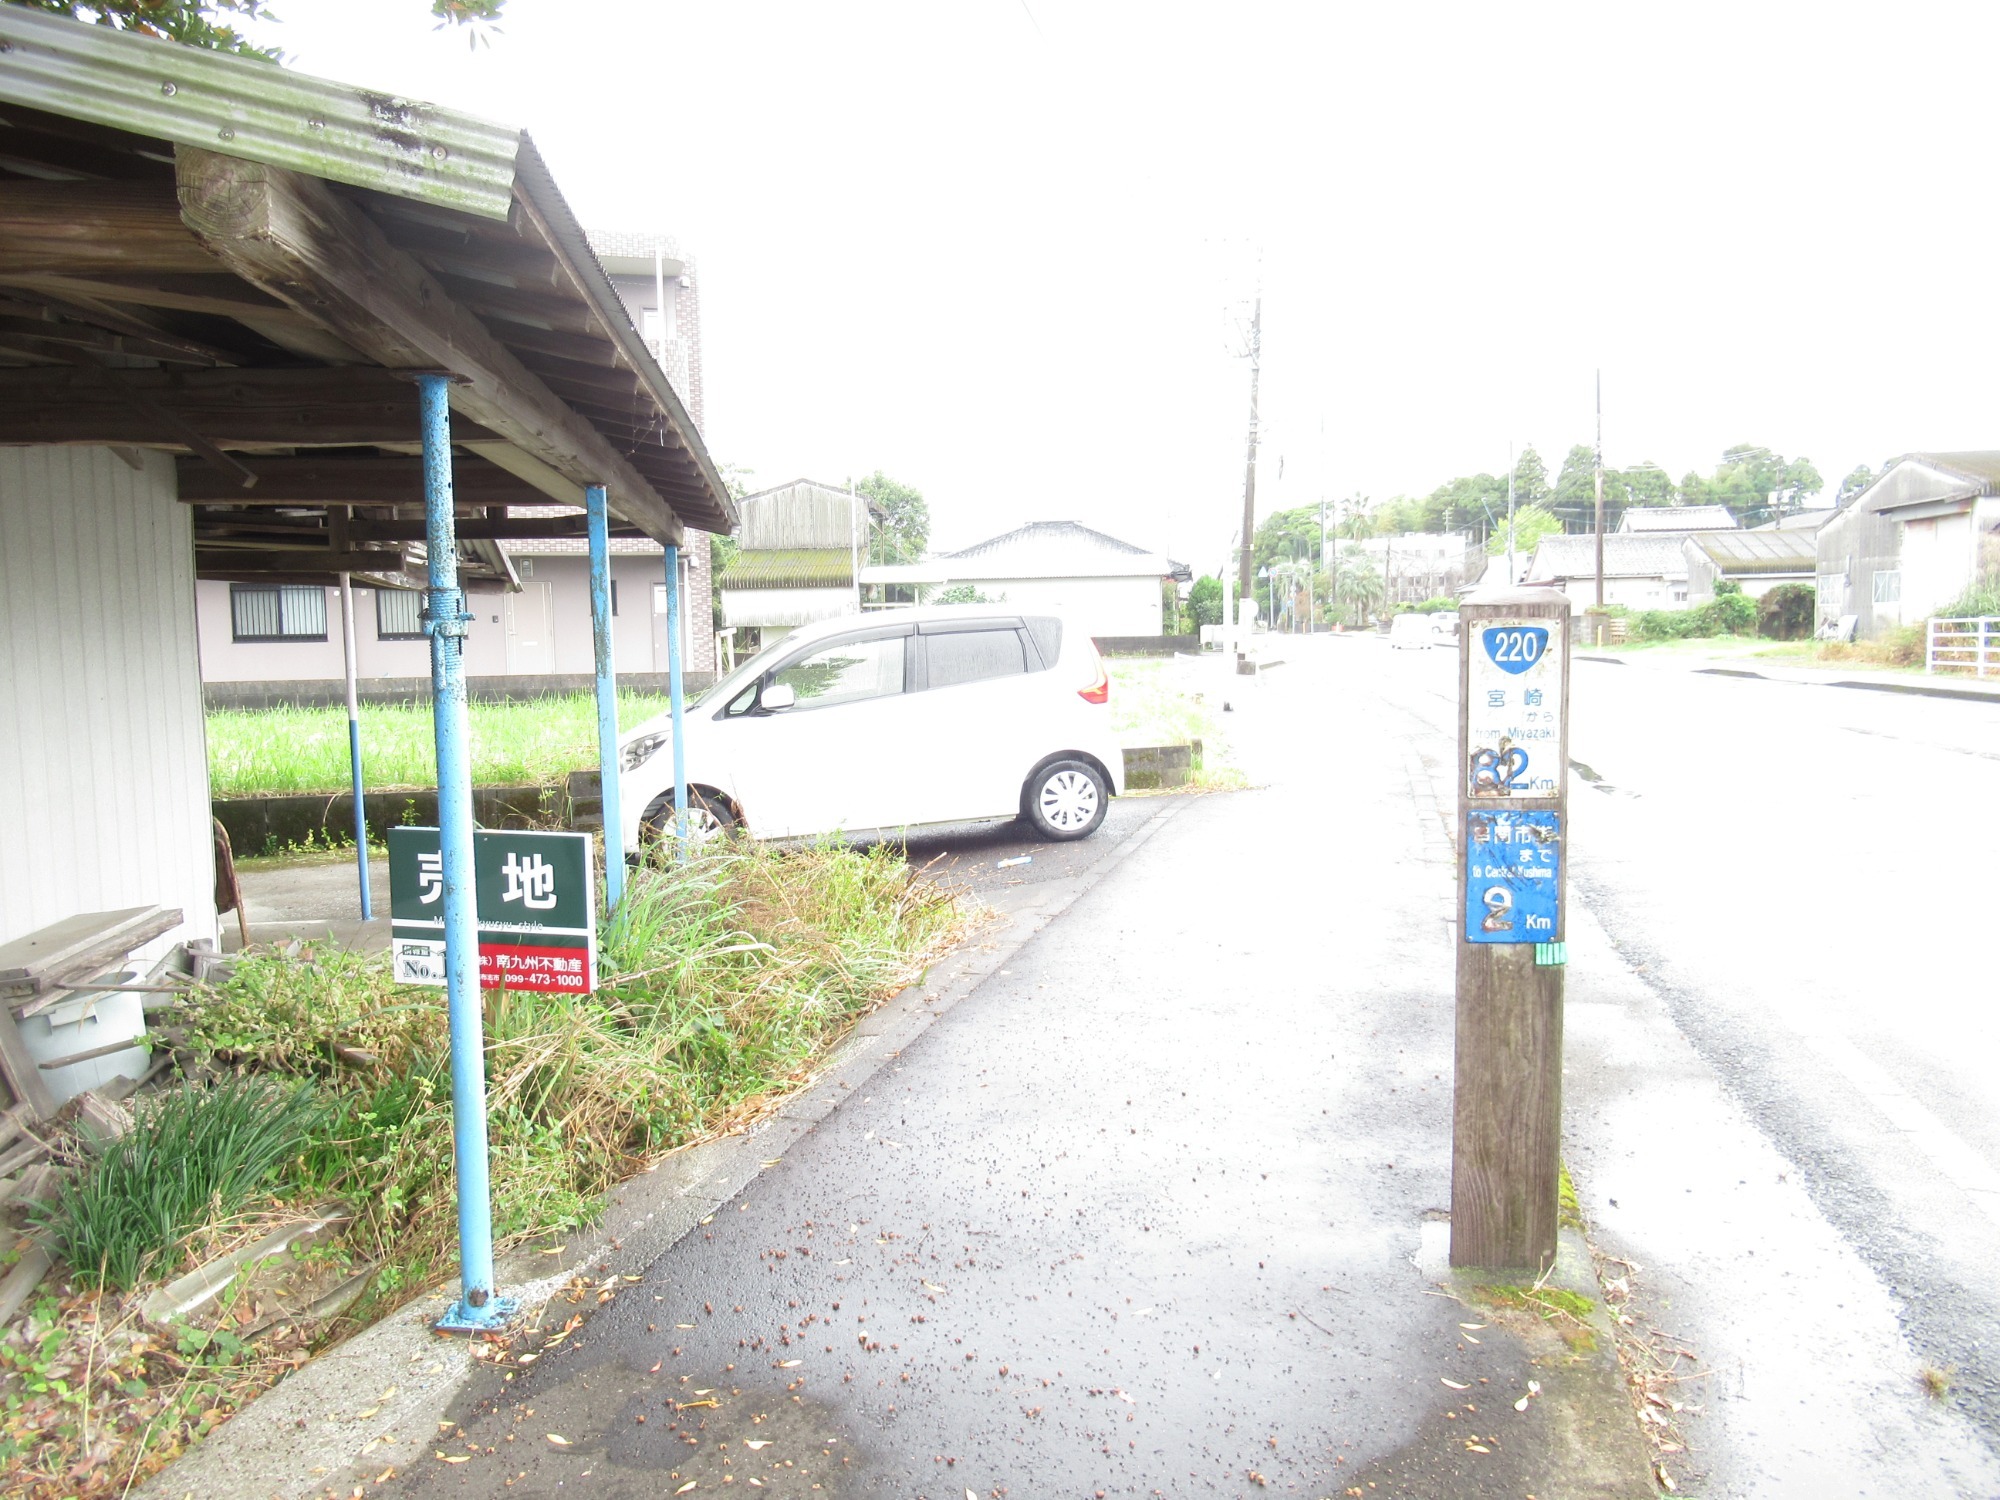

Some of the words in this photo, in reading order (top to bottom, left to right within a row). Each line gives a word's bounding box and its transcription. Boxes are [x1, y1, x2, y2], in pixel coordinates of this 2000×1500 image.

[1494, 632, 1538, 662] 220
[1475, 728, 1500, 739] from
[1507, 727, 1556, 741] Miyazaki
[1519, 849, 1552, 863] まで
[1472, 865, 1482, 878] to
[1482, 886, 1513, 932] 2
[1526, 914, 1551, 930] Km
[518, 921, 544, 931] style
[504, 974, 583, 987] 099-473-1000
